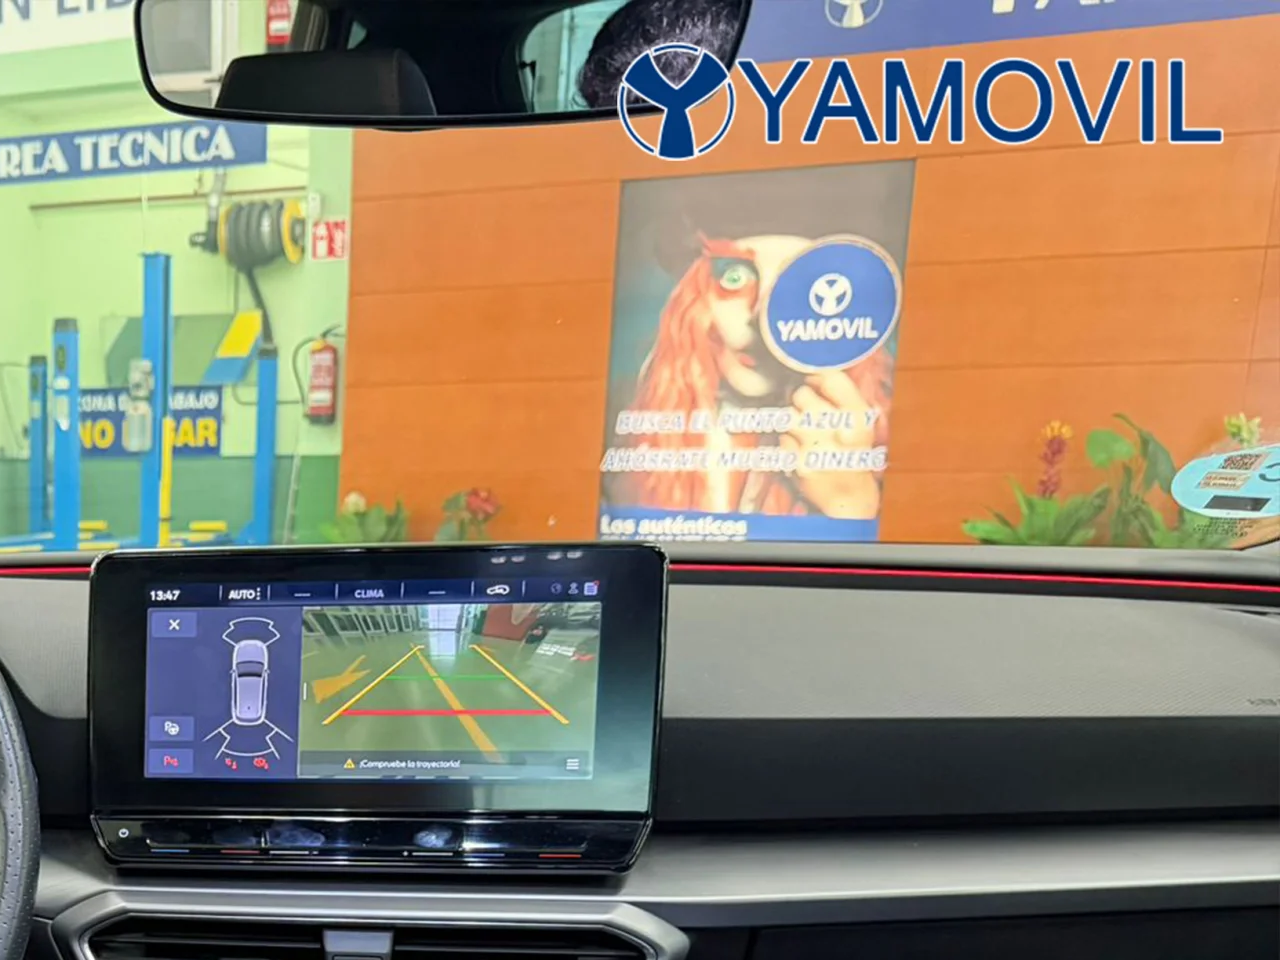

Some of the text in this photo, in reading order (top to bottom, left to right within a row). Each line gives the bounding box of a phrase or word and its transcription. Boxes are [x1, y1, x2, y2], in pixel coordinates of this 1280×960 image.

[74, 124, 235, 171] TECNICA
[777, 316, 879, 342] YAMOVIL
[617, 411, 684, 433] BUSCA
[720, 409, 793, 431] PUNTO
[798, 410, 854, 430] AZUL
[863, 409, 878, 428] Y
[716, 448, 798, 471] MUCHO
[802, 446, 888, 470] DINERO
[600, 514, 636, 535] Los
[150, 590, 181, 601] 13:47
[228, 589, 256, 600] AUTO
[354, 588, 385, 599] CLIMA
